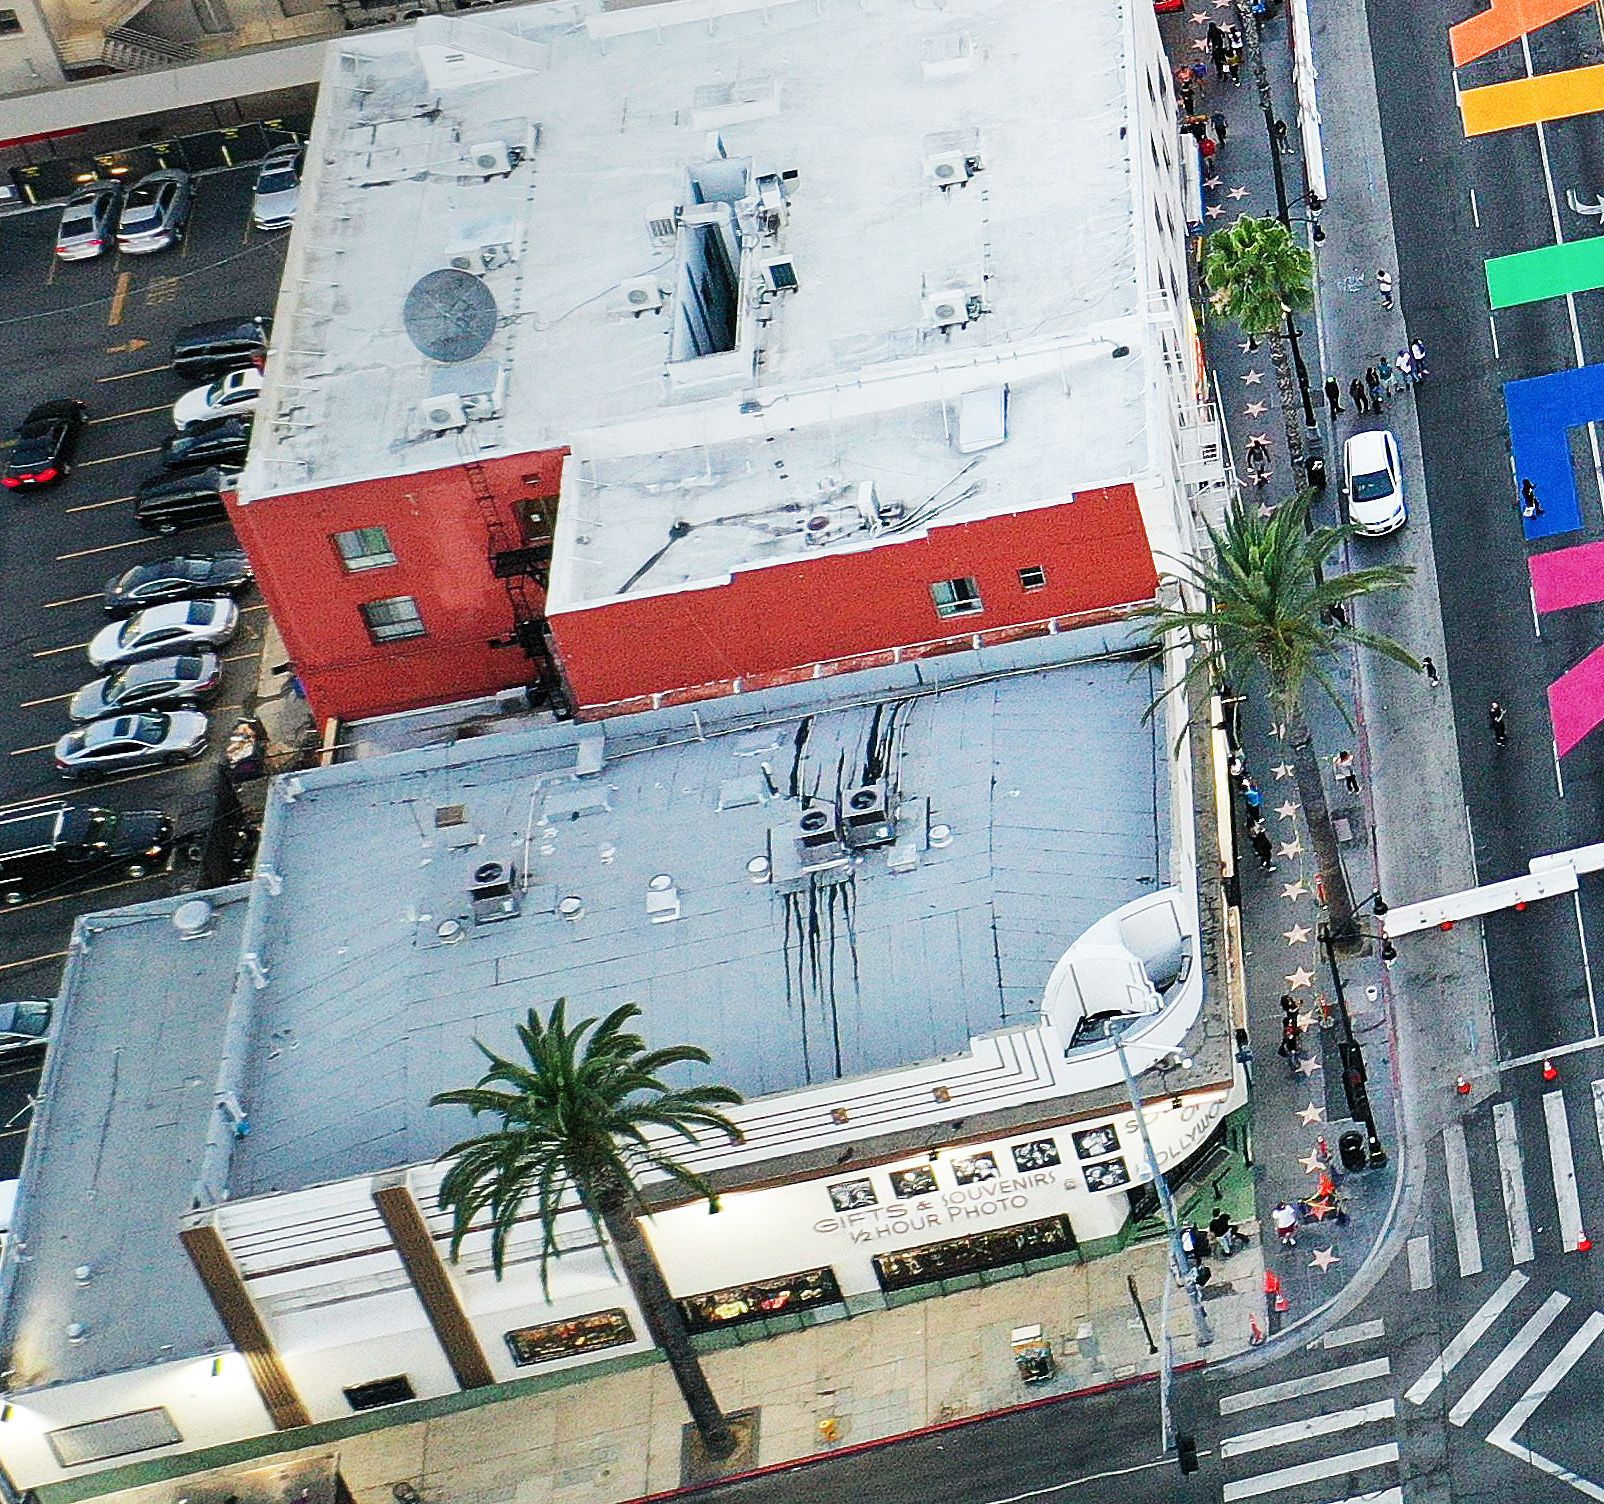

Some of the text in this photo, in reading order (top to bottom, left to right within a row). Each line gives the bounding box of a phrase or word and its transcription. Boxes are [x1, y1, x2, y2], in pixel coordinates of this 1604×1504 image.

[813, 1171, 1057, 1235] GIFTS & SOUVENIRS
[875, 1215, 940, 1239] HOUR
[948, 1194, 1029, 1223] PHOTO
